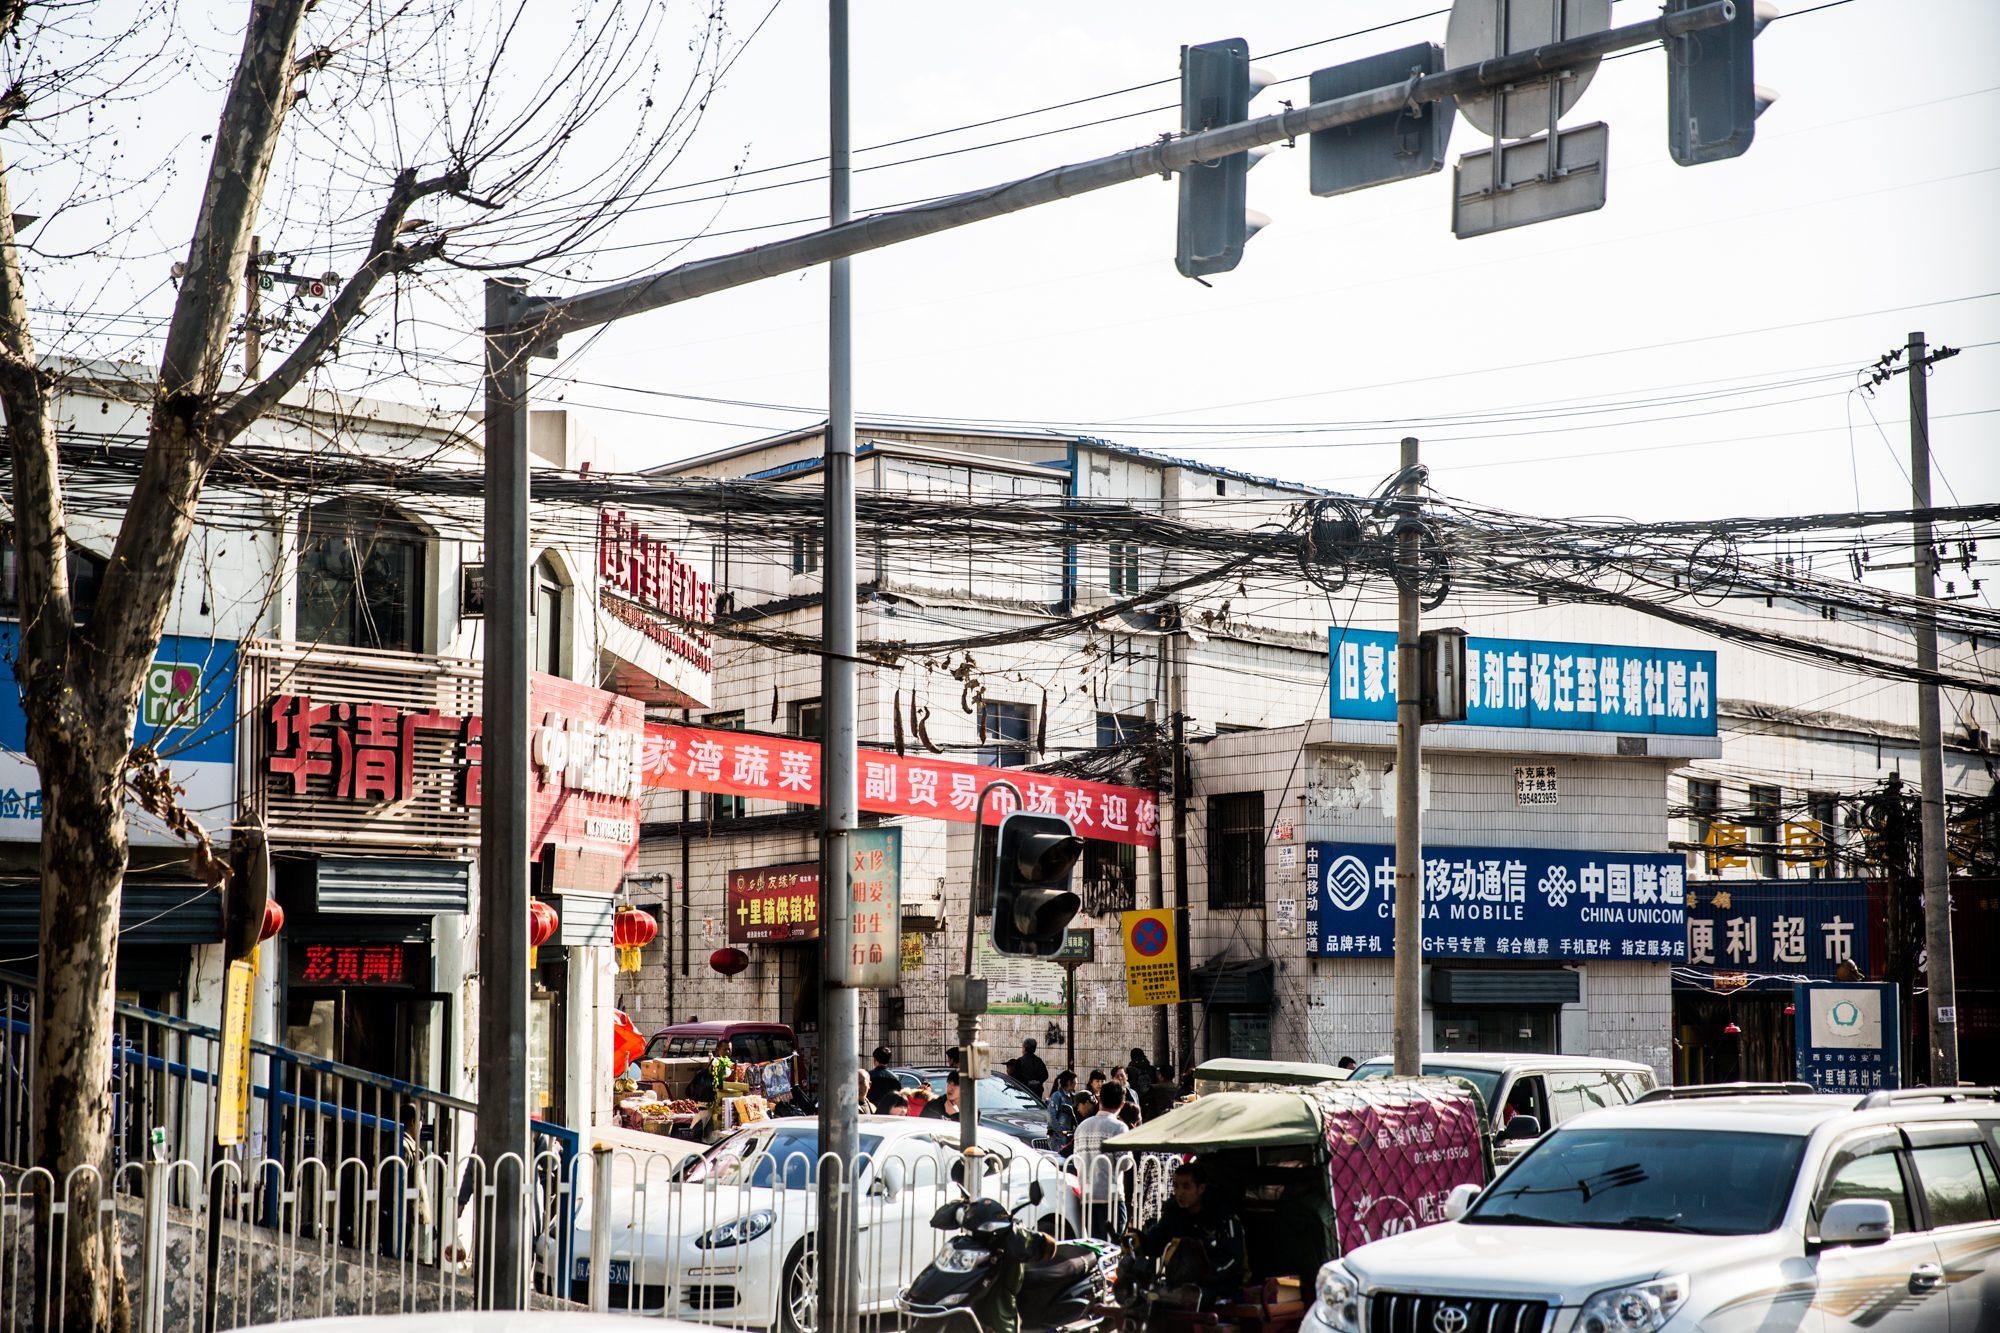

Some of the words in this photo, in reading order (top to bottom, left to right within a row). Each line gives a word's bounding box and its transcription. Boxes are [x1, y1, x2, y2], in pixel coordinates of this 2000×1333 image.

[1306, 847, 1319, 912] 中国移动
[1374, 857, 1528, 903] 中移动通信
[1580, 862, 1684, 905] 中国联通
[736, 894, 817, 926] 十里铺供销社
[852, 851, 867, 966] 文明出行
[869, 850, 883, 965] 珍爱生命
[1450, 904, 1524, 921] MOBILE
[1580, 907, 1624, 923] CHINA
[1627, 909, 1684, 924] UNICOM
[1306, 920, 1319, 953] 联通
[1326, 935, 1382, 952] 品牌手机
[1496, 938, 1550, 954] 综合缴费
[1559, 938, 1612, 955] 手机配件
[1621, 939, 1685, 956] 指定服务店
[1812, 1053, 1881, 1062] 西安市公安局
[1813, 1068, 1882, 1087] 十里铺派出所
